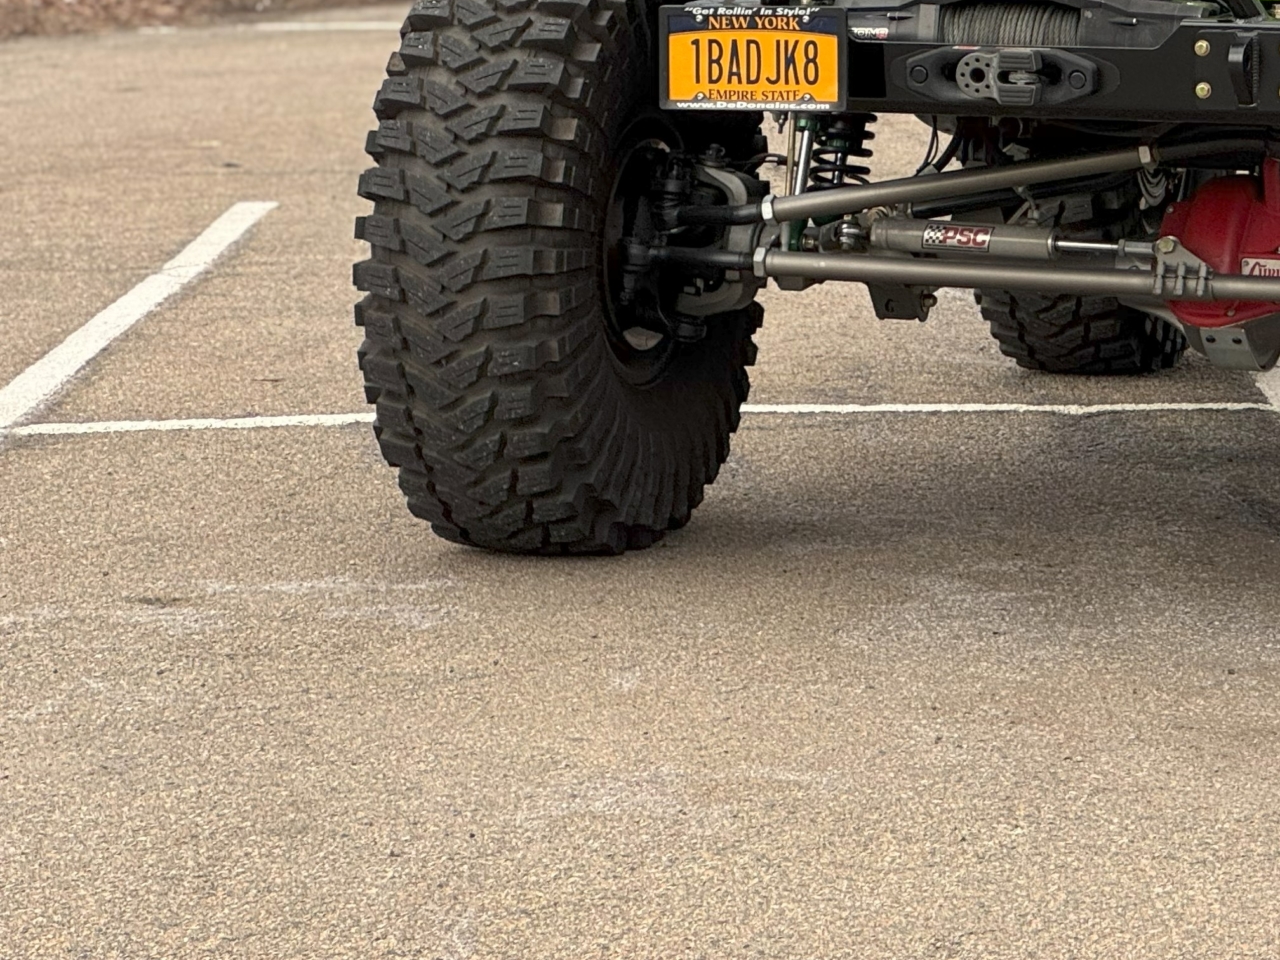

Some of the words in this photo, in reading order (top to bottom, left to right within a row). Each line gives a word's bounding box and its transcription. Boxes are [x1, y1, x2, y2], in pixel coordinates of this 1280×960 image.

[760, 7, 775, 16] In
[708, 16, 750, 30] NEW
[754, 16, 801, 30] YORK
[691, 38, 819, 86] 1BADJK8
[708, 88, 758, 101] EMPIRE
[761, 89, 800, 101] STATE
[941, 226, 990, 247] PSC
